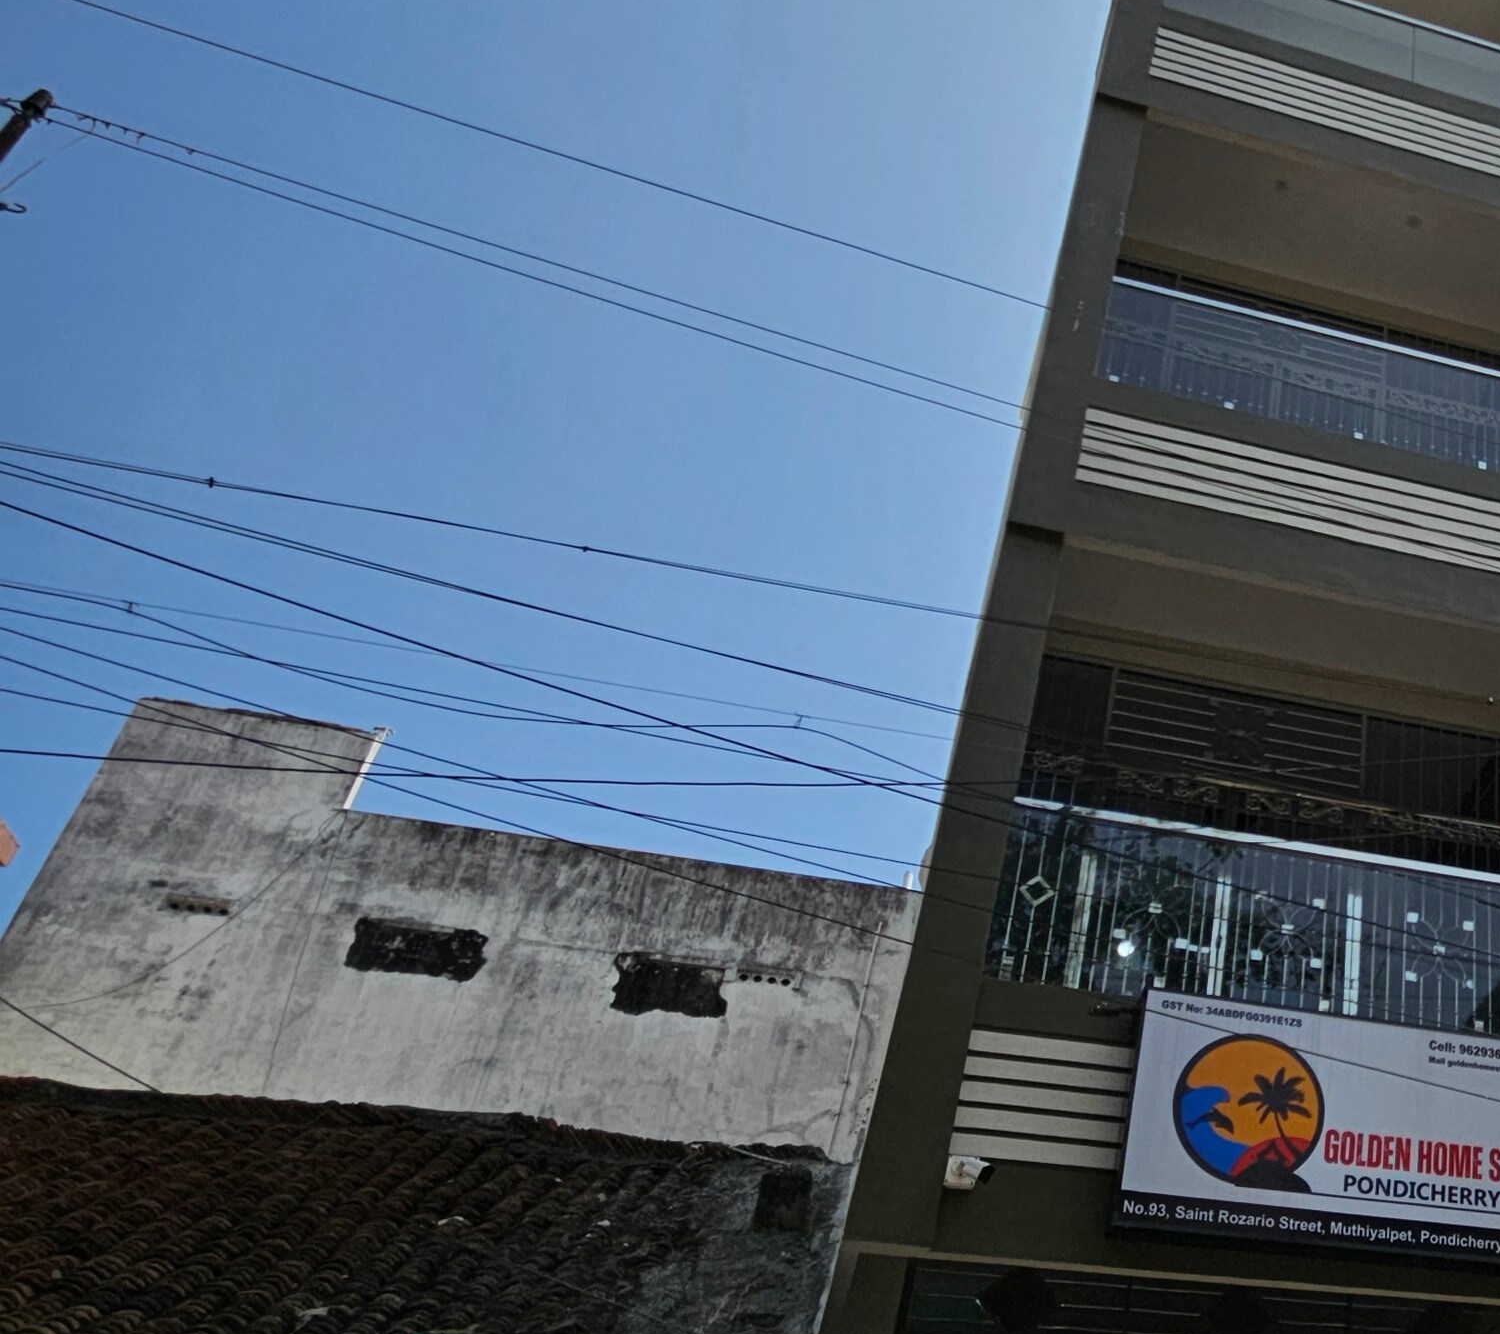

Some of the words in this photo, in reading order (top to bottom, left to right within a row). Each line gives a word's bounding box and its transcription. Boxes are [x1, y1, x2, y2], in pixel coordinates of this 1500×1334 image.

[1161, 1000, 1184, 1010] GST
[1186, 1003, 1203, 1014] No:
[1428, 1039, 1456, 1054] Cell:
[1428, 1055, 1446, 1066] Mail
[1323, 1129, 1411, 1172] GOLDEN
[1417, 1139, 1484, 1180] HOME
[1343, 1174, 1500, 1209] PONDICHERRY
[1122, 1199, 1170, 1219] No.93,
[1174, 1205, 1214, 1223] Saint
[1217, 1209, 1275, 1228] Rozario
[1278, 1216, 1326, 1235] Street,
[1329, 1221, 1416, 1244] Muthiyalpet,
